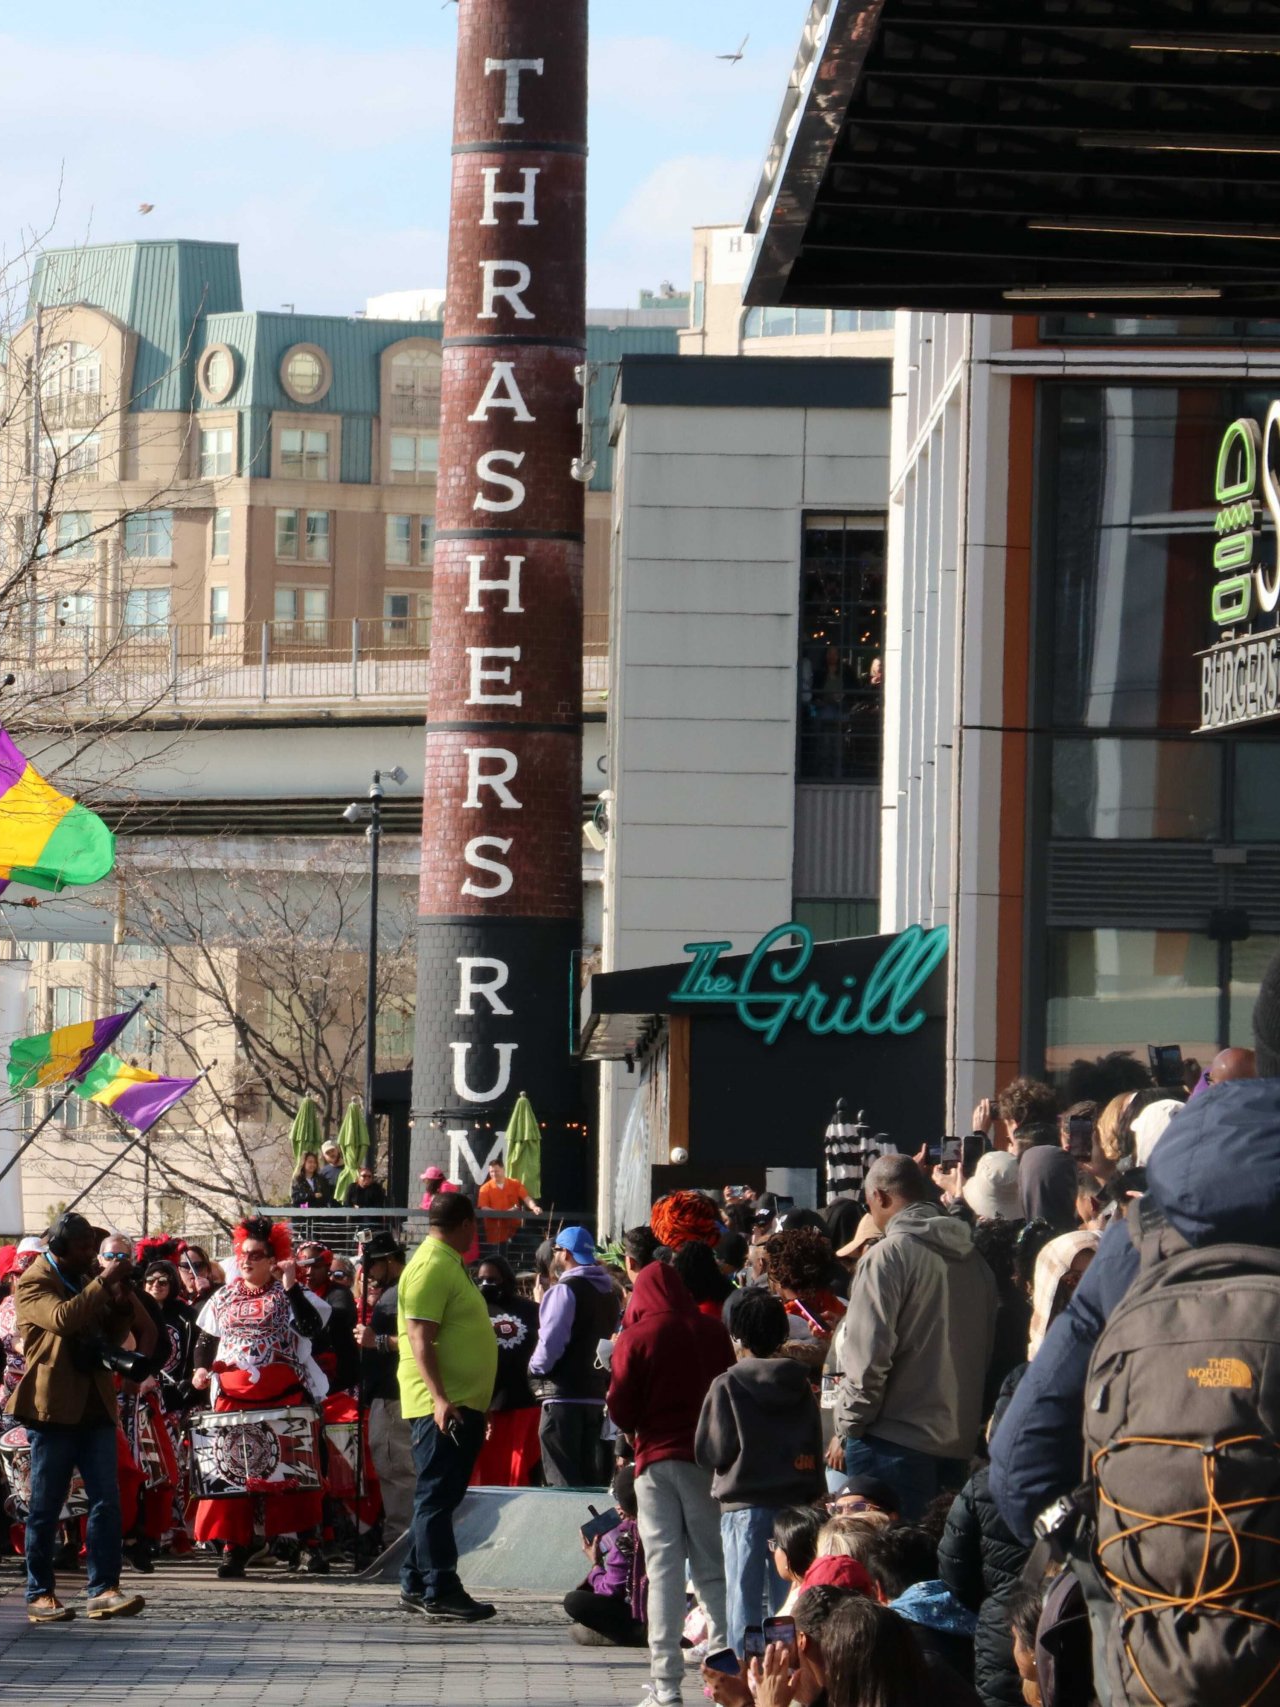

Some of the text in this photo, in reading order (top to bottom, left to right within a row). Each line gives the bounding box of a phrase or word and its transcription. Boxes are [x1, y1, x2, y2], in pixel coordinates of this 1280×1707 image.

[461, 57, 544, 898] THRASHERS
[1201, 638, 1278, 727] BURGERS
[683, 921, 949, 1045] The Grill
[447, 957, 518, 1186] RUM
[1187, 1368, 1231, 1379] NORTH
[1198, 1378, 1231, 1388] FACE
[1208, 1358, 1231, 1368] THE
